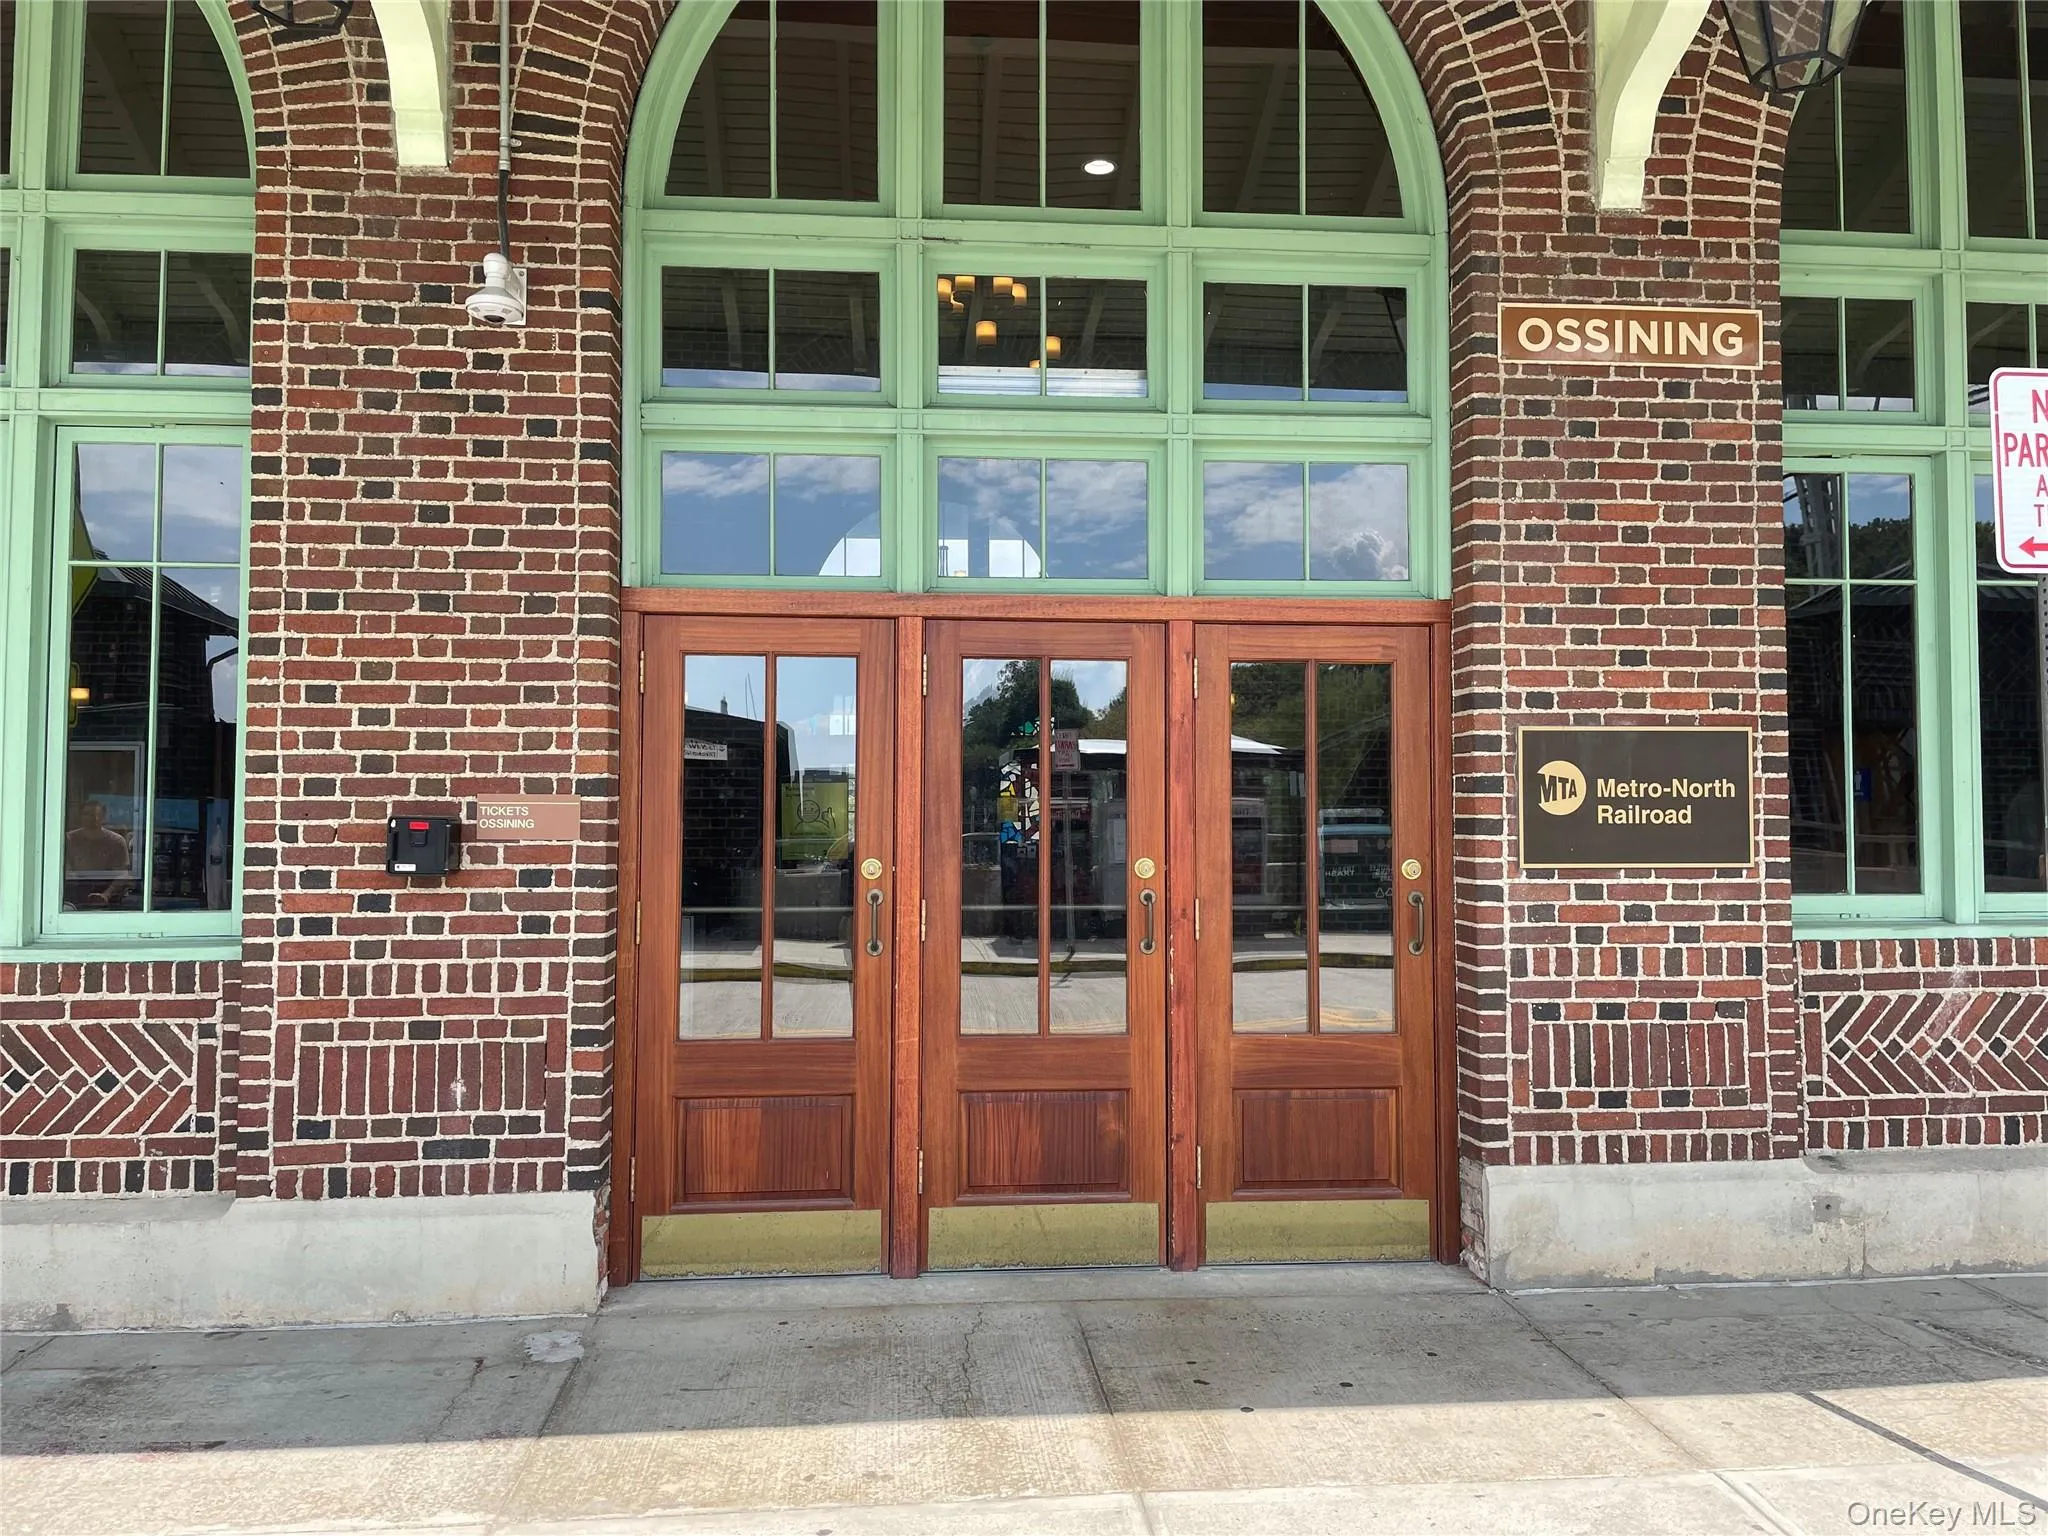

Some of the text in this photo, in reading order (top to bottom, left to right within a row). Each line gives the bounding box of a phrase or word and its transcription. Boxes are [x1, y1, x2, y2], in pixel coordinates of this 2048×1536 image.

[1517, 317, 1743, 357] OSSINING
[2032, 389, 2048, 424] N
[2004, 432, 2048, 468] PAR
[2036, 474, 2048, 498] A
[2034, 503, 2048, 528] T
[1537, 773, 1578, 804] MTA
[1597, 778, 1736, 798] Metro-North
[480, 806, 529, 816] TICKETS
[1597, 804, 1692, 825] Railroad
[479, 818, 535, 829] OSSINING
